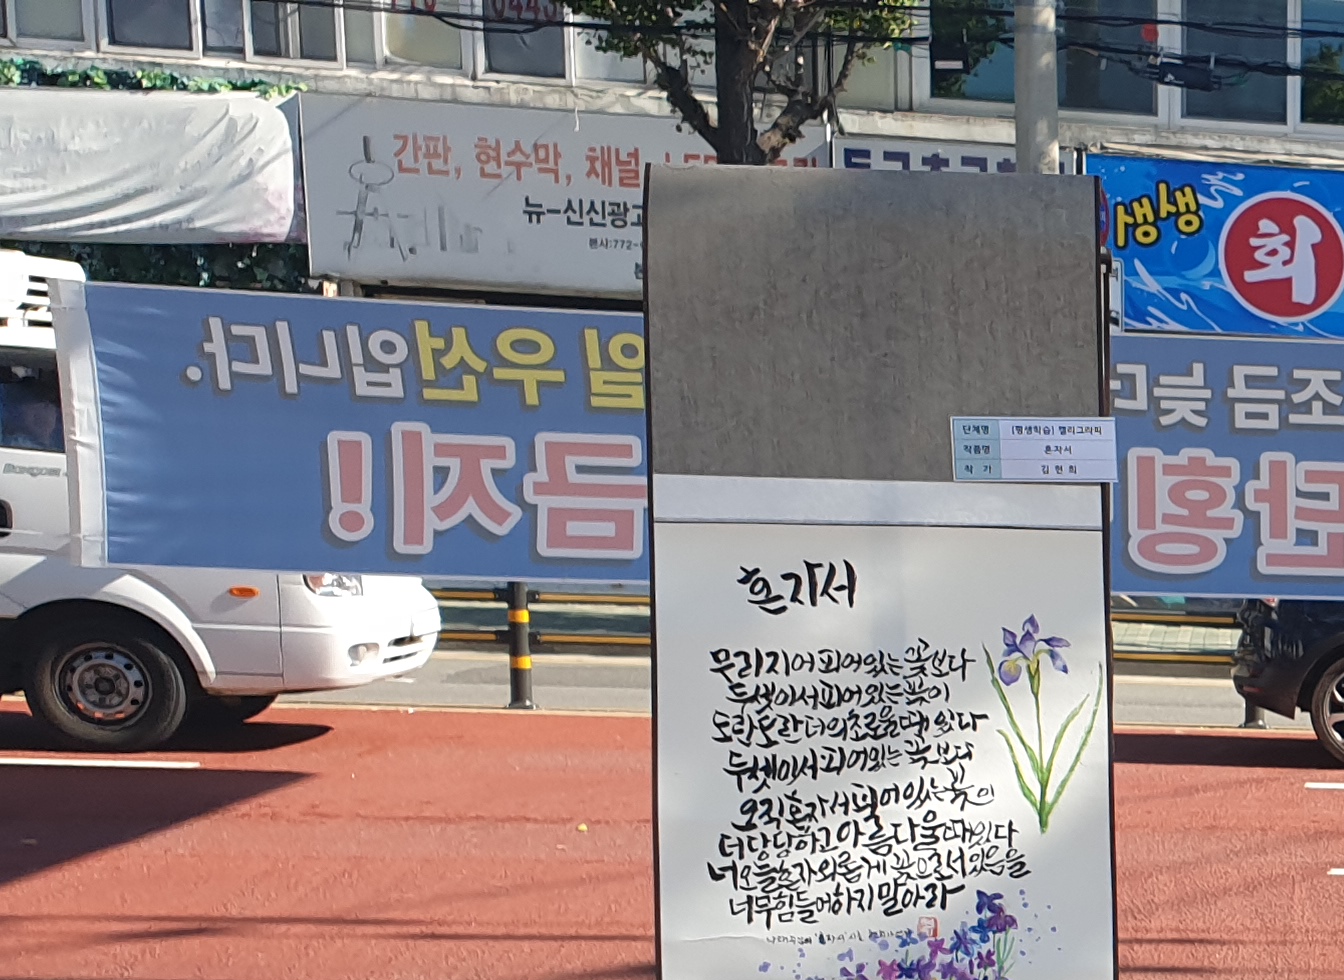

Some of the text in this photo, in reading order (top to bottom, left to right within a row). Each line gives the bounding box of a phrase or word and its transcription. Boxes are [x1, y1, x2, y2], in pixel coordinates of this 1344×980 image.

[393, 132, 641, 188] 간판, 현수막, 채널
[1115, 181, 1201, 249] 생생
[1243, 214, 1322, 304] 회
[962, 425, 990, 435] 단체명
[1058, 425, 1102, 436] 캘리그라피
[963, 444, 1073, 455] 작품명 혼자서
[737, 558, 858, 616] 혼자서
